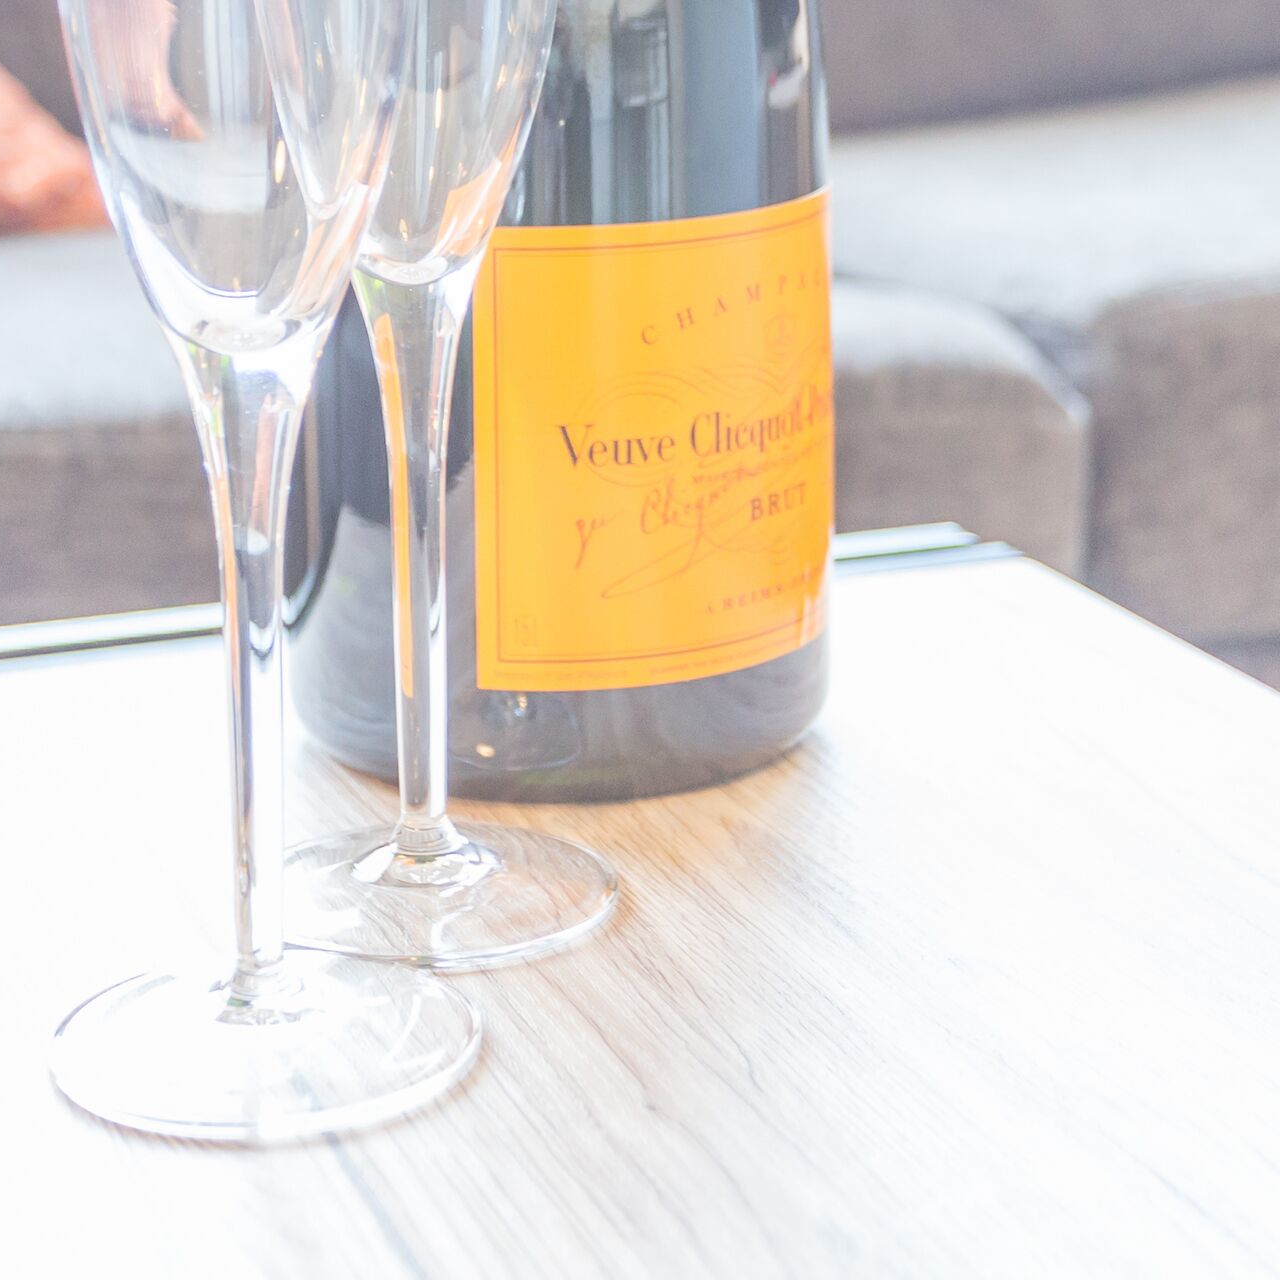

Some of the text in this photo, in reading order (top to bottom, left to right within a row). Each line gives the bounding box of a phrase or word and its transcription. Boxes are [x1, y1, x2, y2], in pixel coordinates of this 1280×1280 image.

[555, 421, 677, 469] Veuve
[689, 399, 804, 459] Clicquot
[750, 481, 807, 522] BRUT
